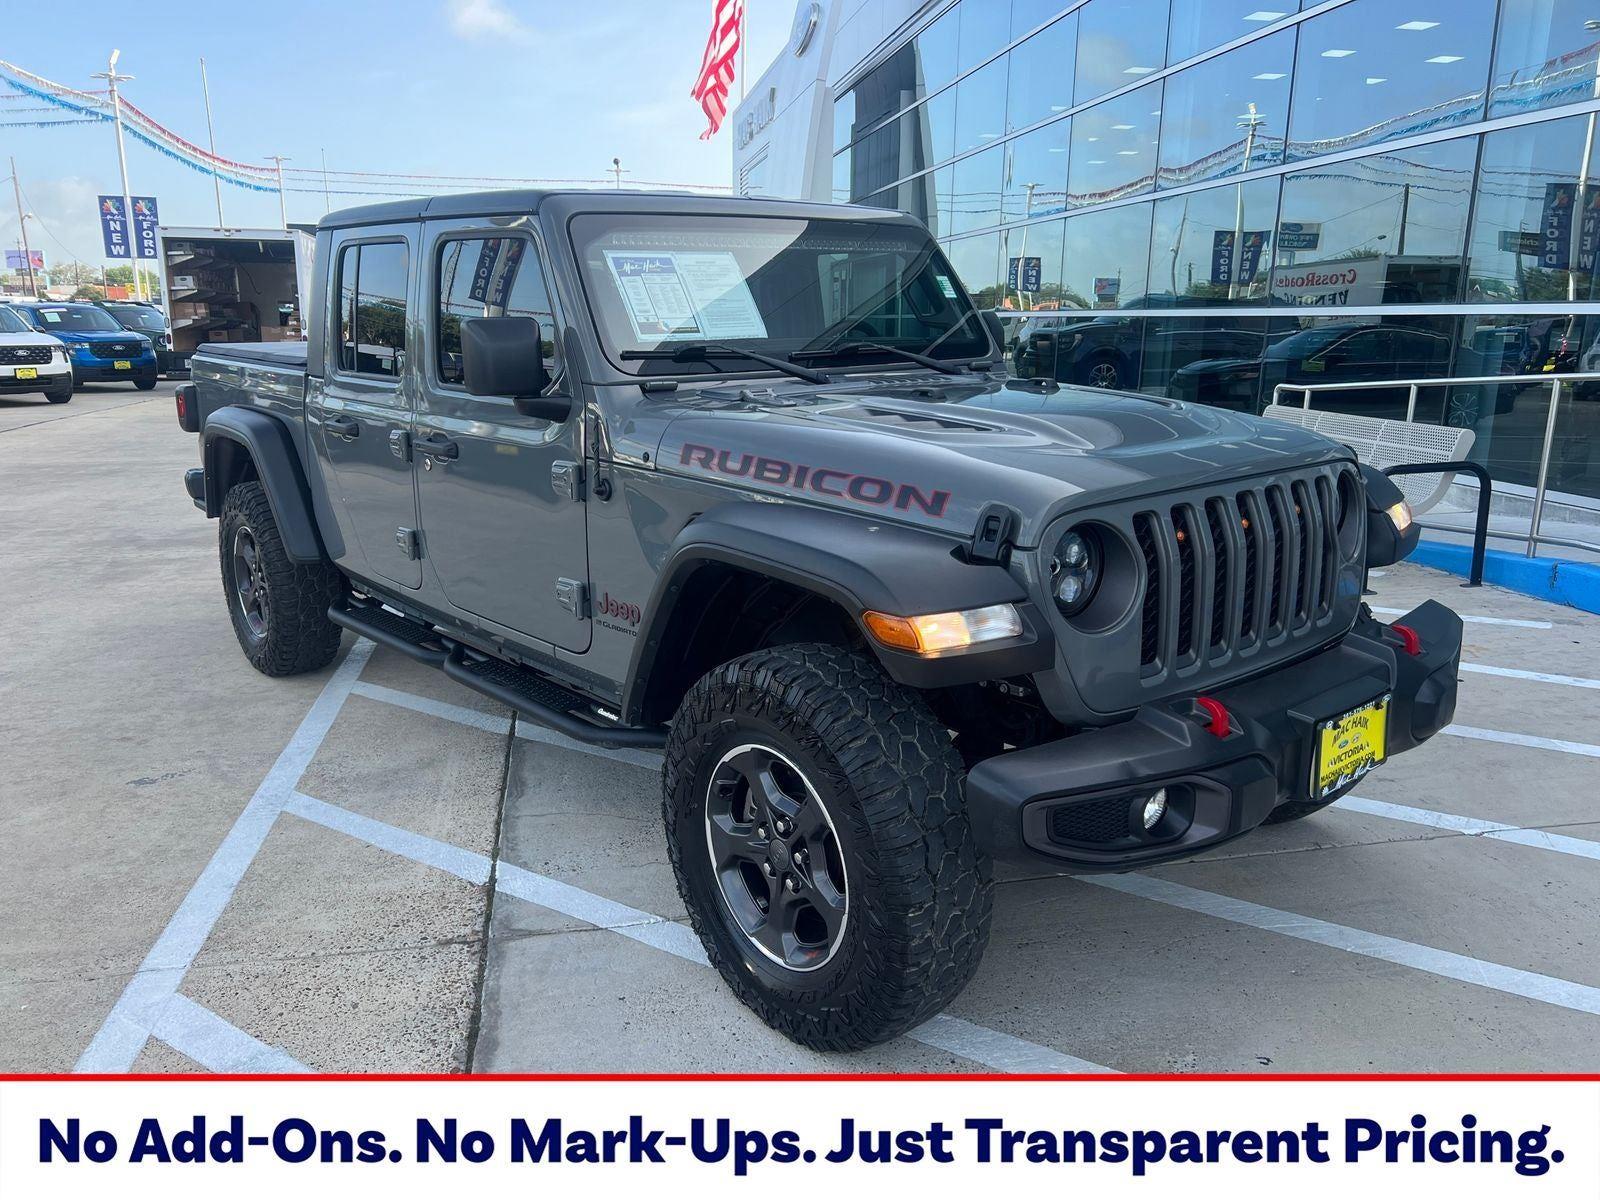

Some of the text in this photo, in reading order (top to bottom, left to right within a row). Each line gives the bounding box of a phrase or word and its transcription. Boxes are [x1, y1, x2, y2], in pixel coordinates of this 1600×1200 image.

[109, 220, 125, 256] NEW
[142, 221, 155, 256] FORD
[680, 443, 951, 518] RUBICON
[598, 591, 641, 627] Jeep
[602, 621, 640, 639] GLADIATO
[1351, 715, 1370, 730] HAIK
